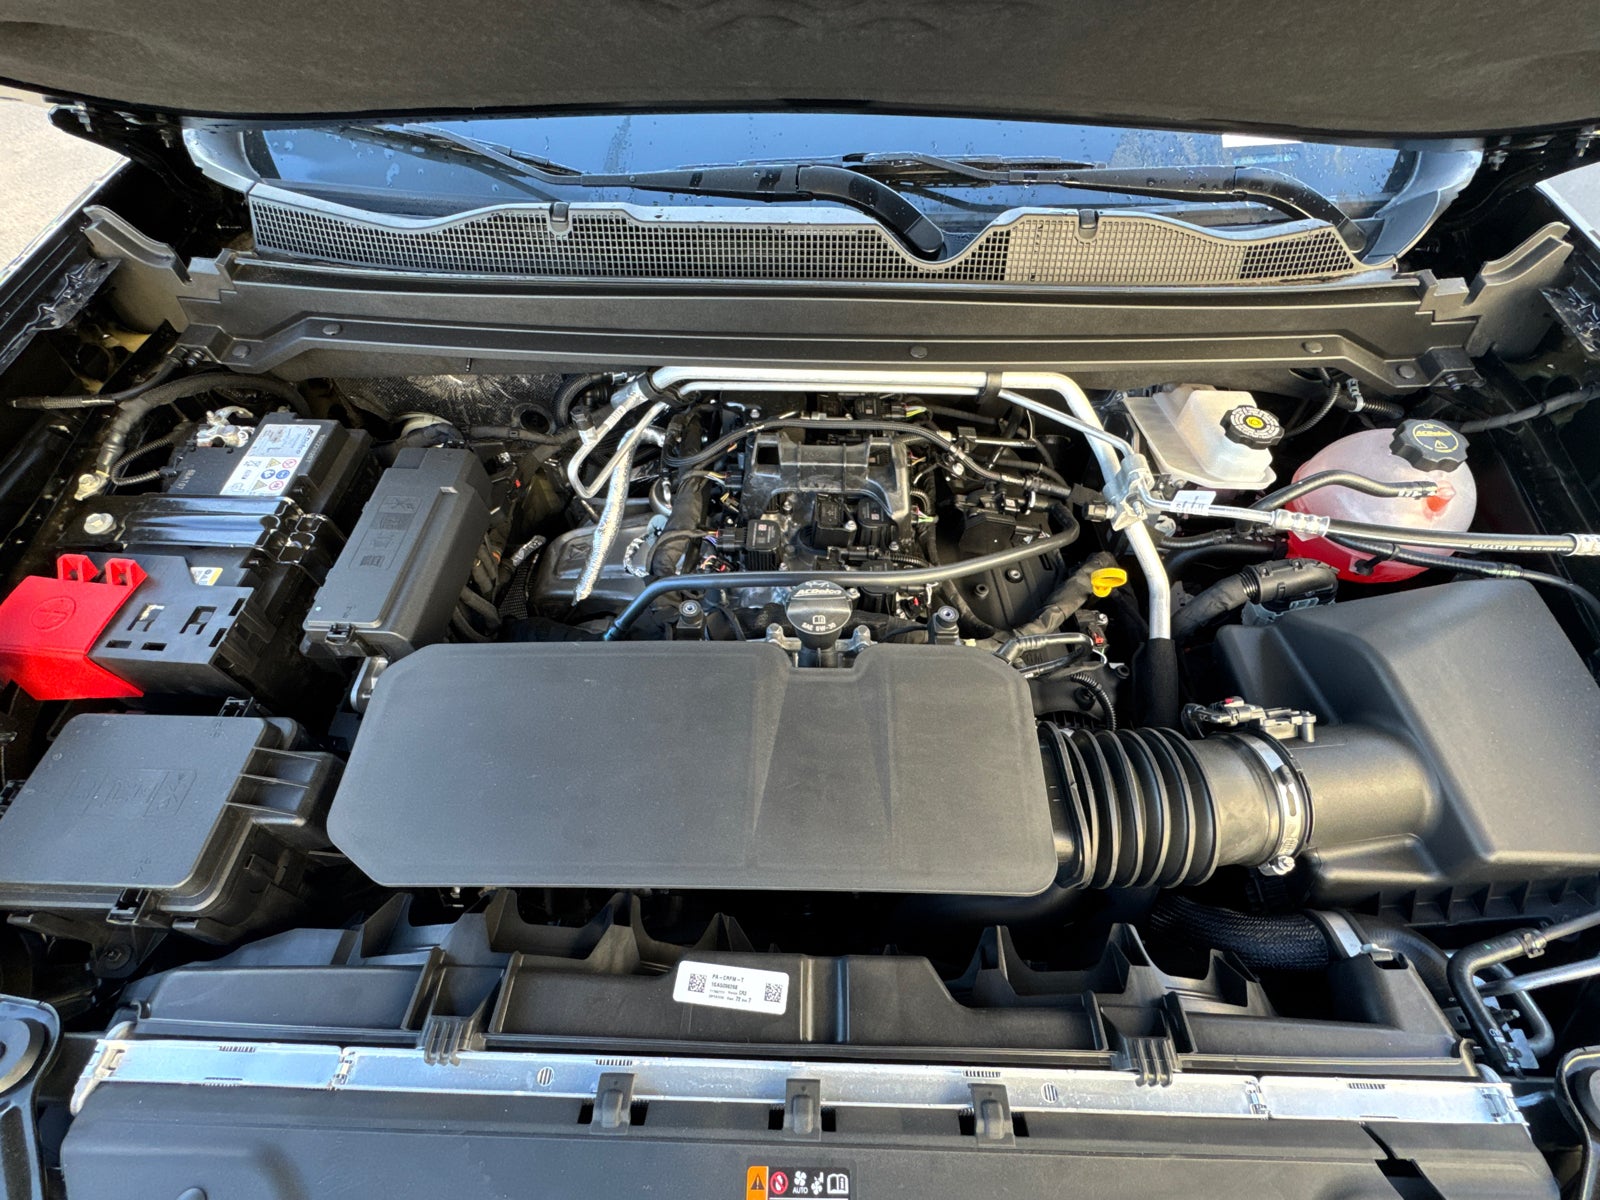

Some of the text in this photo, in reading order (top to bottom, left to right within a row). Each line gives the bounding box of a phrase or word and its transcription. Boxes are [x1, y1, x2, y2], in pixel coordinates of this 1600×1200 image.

[794, 588, 842, 597] ACDelco
[801, 622, 837, 632] SAE 5W-30
